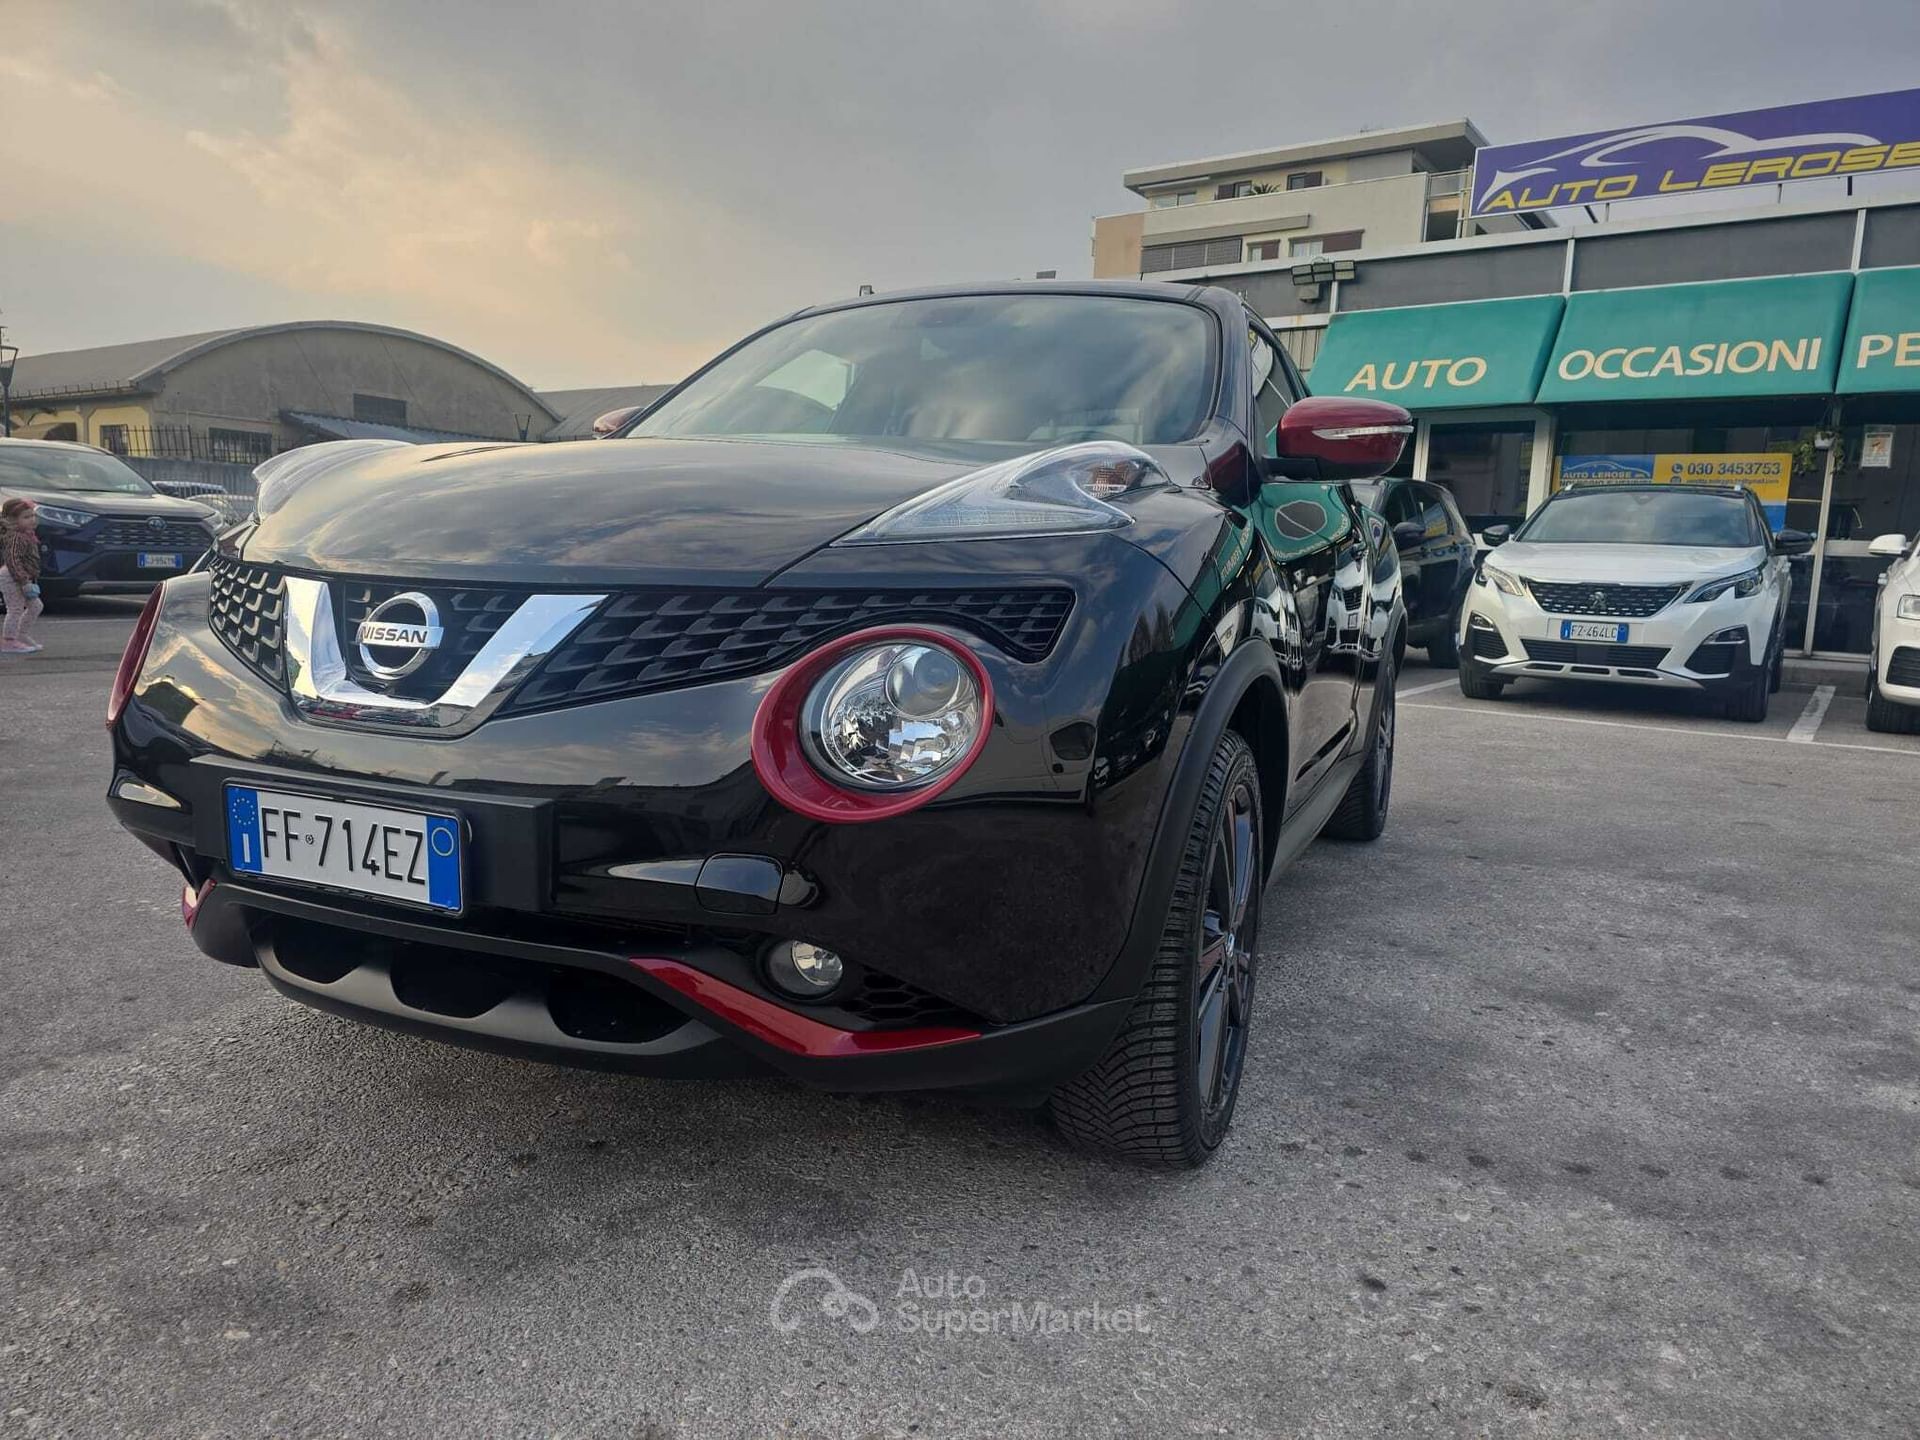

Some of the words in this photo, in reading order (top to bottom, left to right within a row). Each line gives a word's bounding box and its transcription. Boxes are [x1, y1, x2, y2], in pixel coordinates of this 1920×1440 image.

[1482, 175, 1638, 212] AUTO
[1659, 140, 1920, 193] LEROSE
[1343, 356, 1488, 393] AUTO
[1558, 337, 1822, 381] OCCASIONI
[1857, 332, 1920, 369] PE
[1562, 471, 1589, 480] AUTO
[1592, 470, 1633, 480] LEROSE
[1687, 462, 1714, 476] 030
[1717, 461, 1781, 476] 3453753
[359, 624, 429, 645] NISSAN
